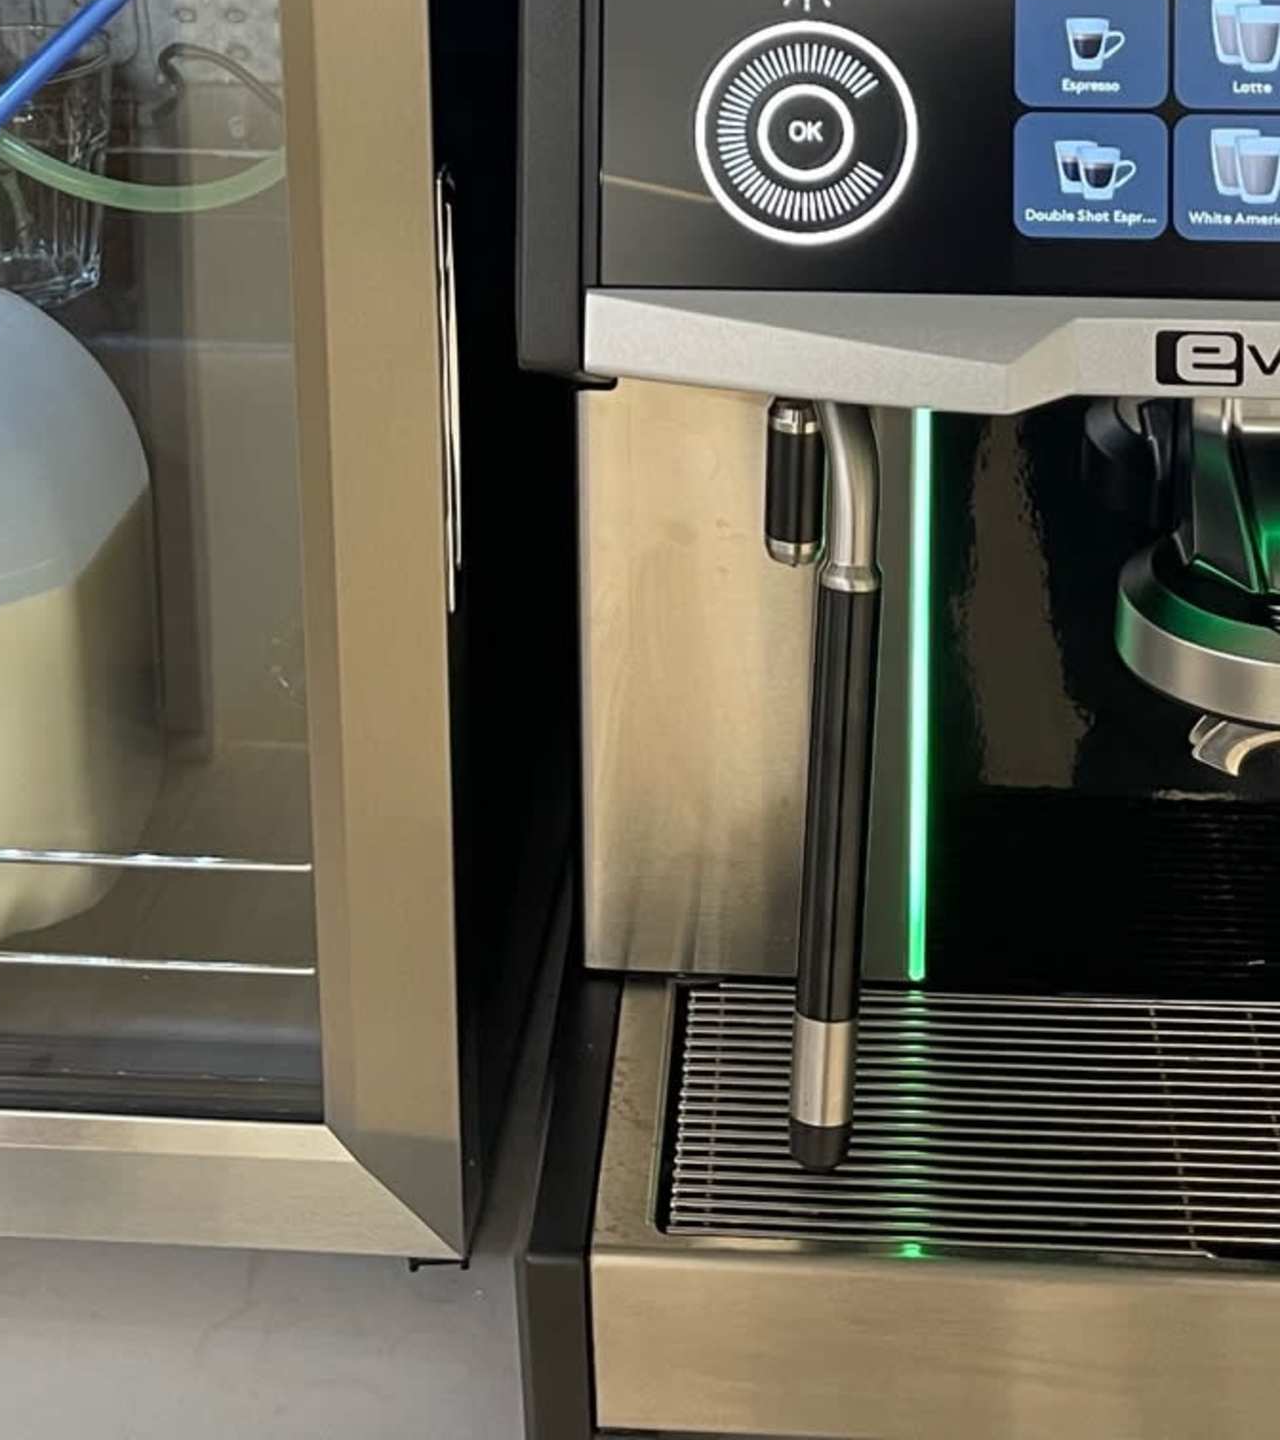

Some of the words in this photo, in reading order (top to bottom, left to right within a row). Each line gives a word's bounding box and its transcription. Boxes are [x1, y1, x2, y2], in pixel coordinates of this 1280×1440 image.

[1061, 78, 1120, 94] Espresso
[1232, 81, 1272, 94] Latte
[788, 121, 824, 143] OK
[1025, 208, 1071, 223] Double
[1076, 208, 1110, 223] Shot
[1188, 210, 1231, 225] White
